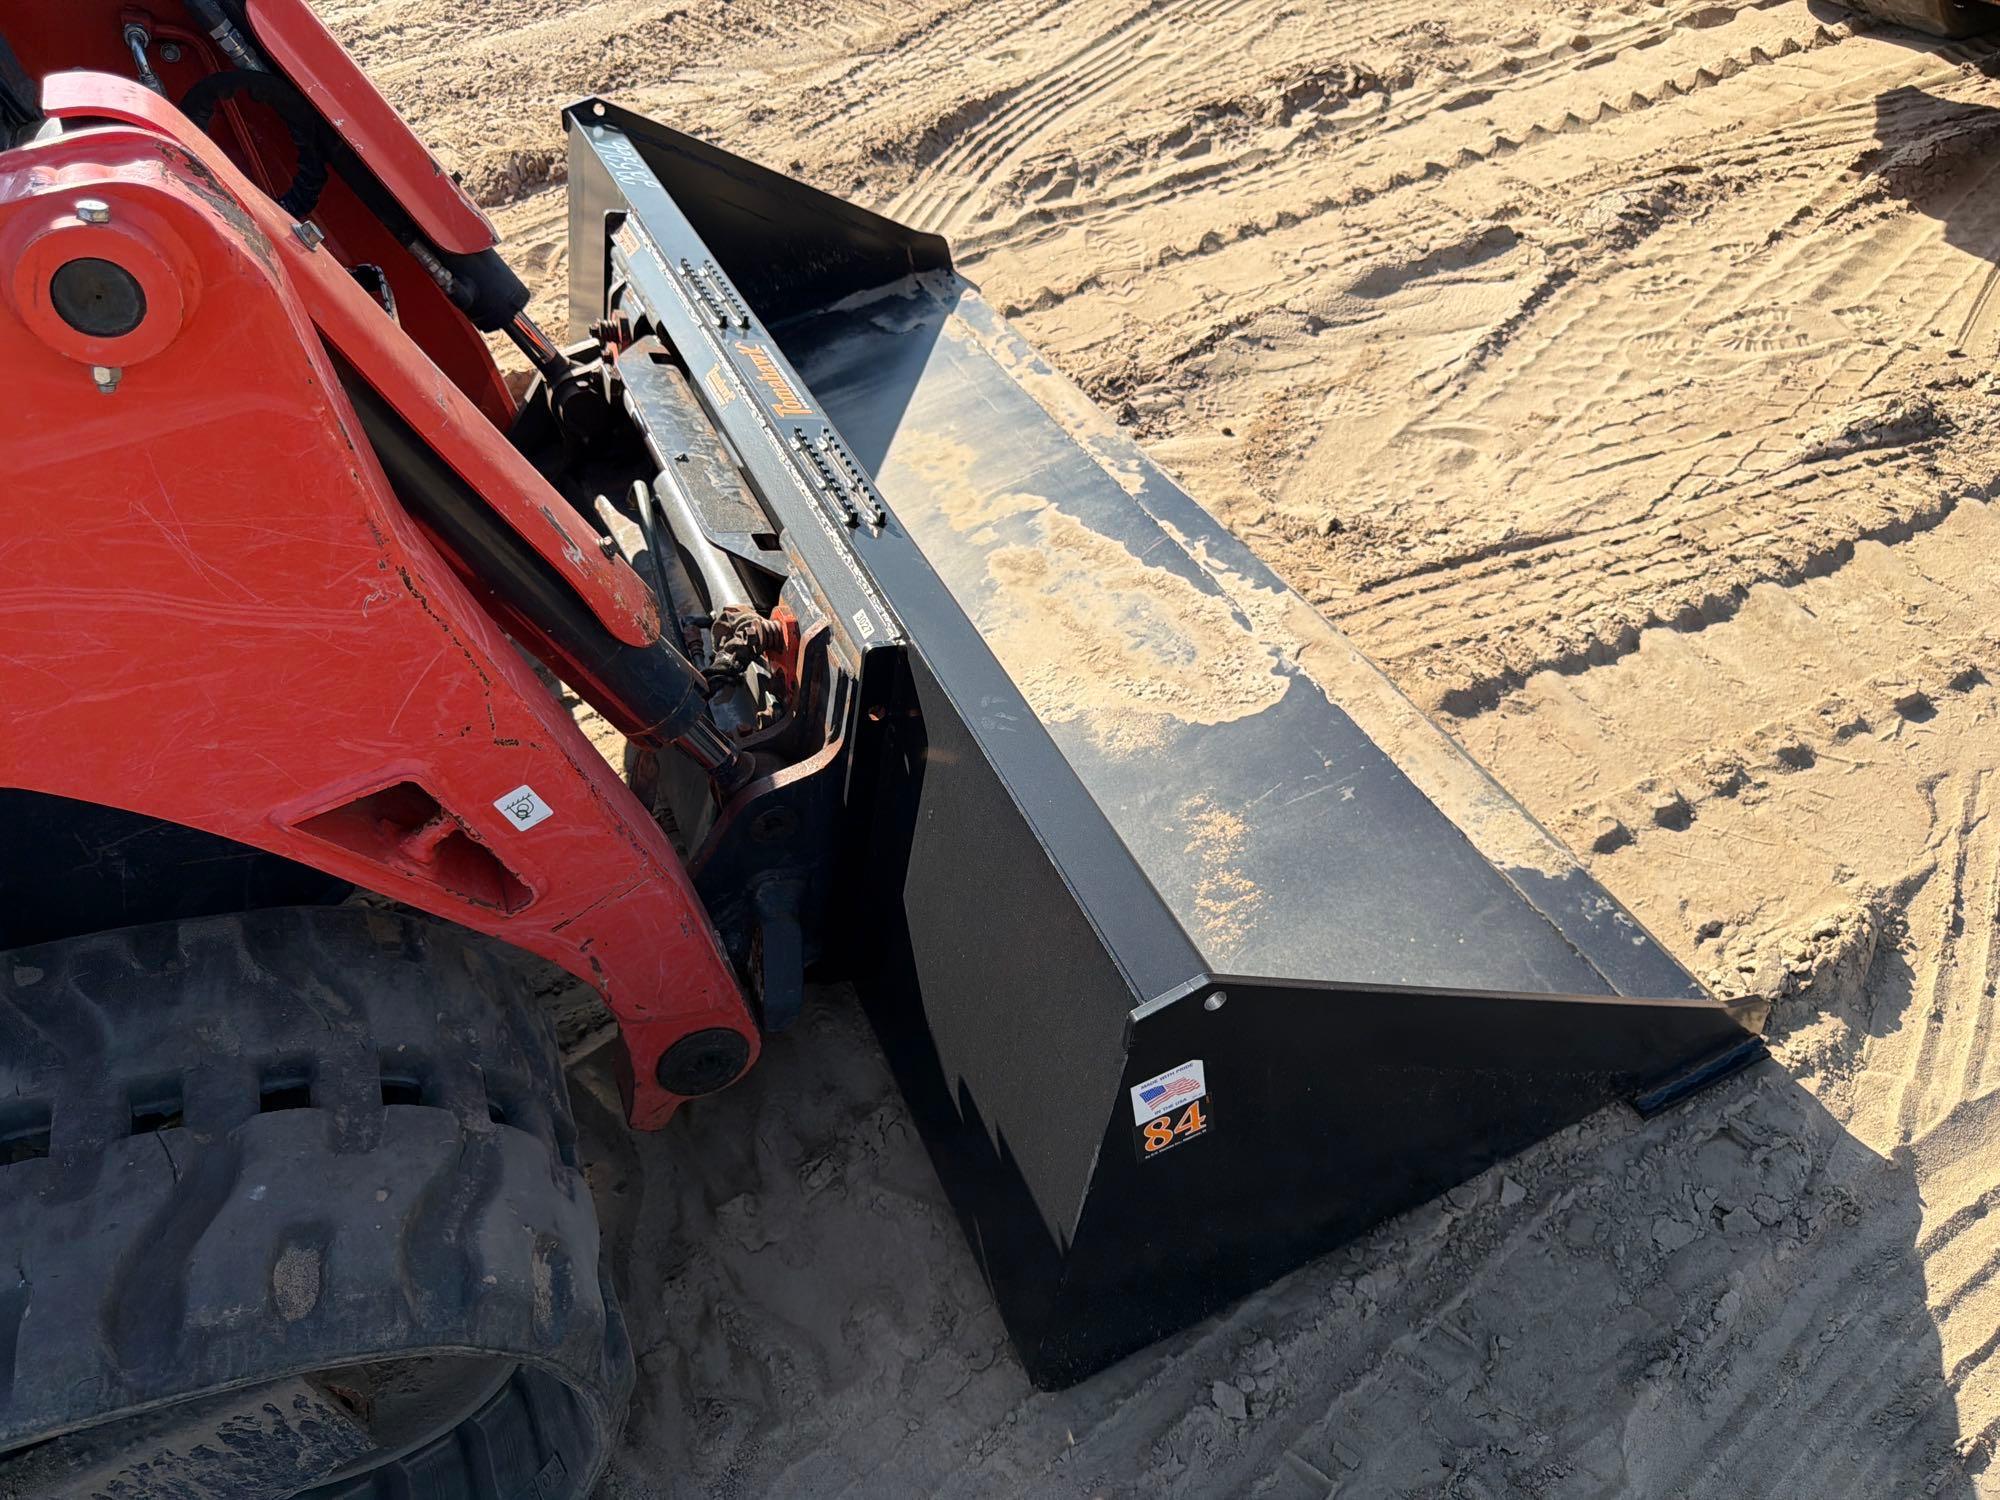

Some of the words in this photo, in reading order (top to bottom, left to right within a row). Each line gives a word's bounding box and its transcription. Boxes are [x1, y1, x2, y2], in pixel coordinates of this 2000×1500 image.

[856, 614, 872, 634] 3027
[1141, 1080, 1158, 1090] MADE
[1160, 1071, 1175, 1081] WITH
[1176, 1063, 1193, 1073] PRIDE
[1163, 1103, 1174, 1112] THE
[1175, 1097, 1187, 1106] USA
[1144, 1100, 1207, 1152] 84
